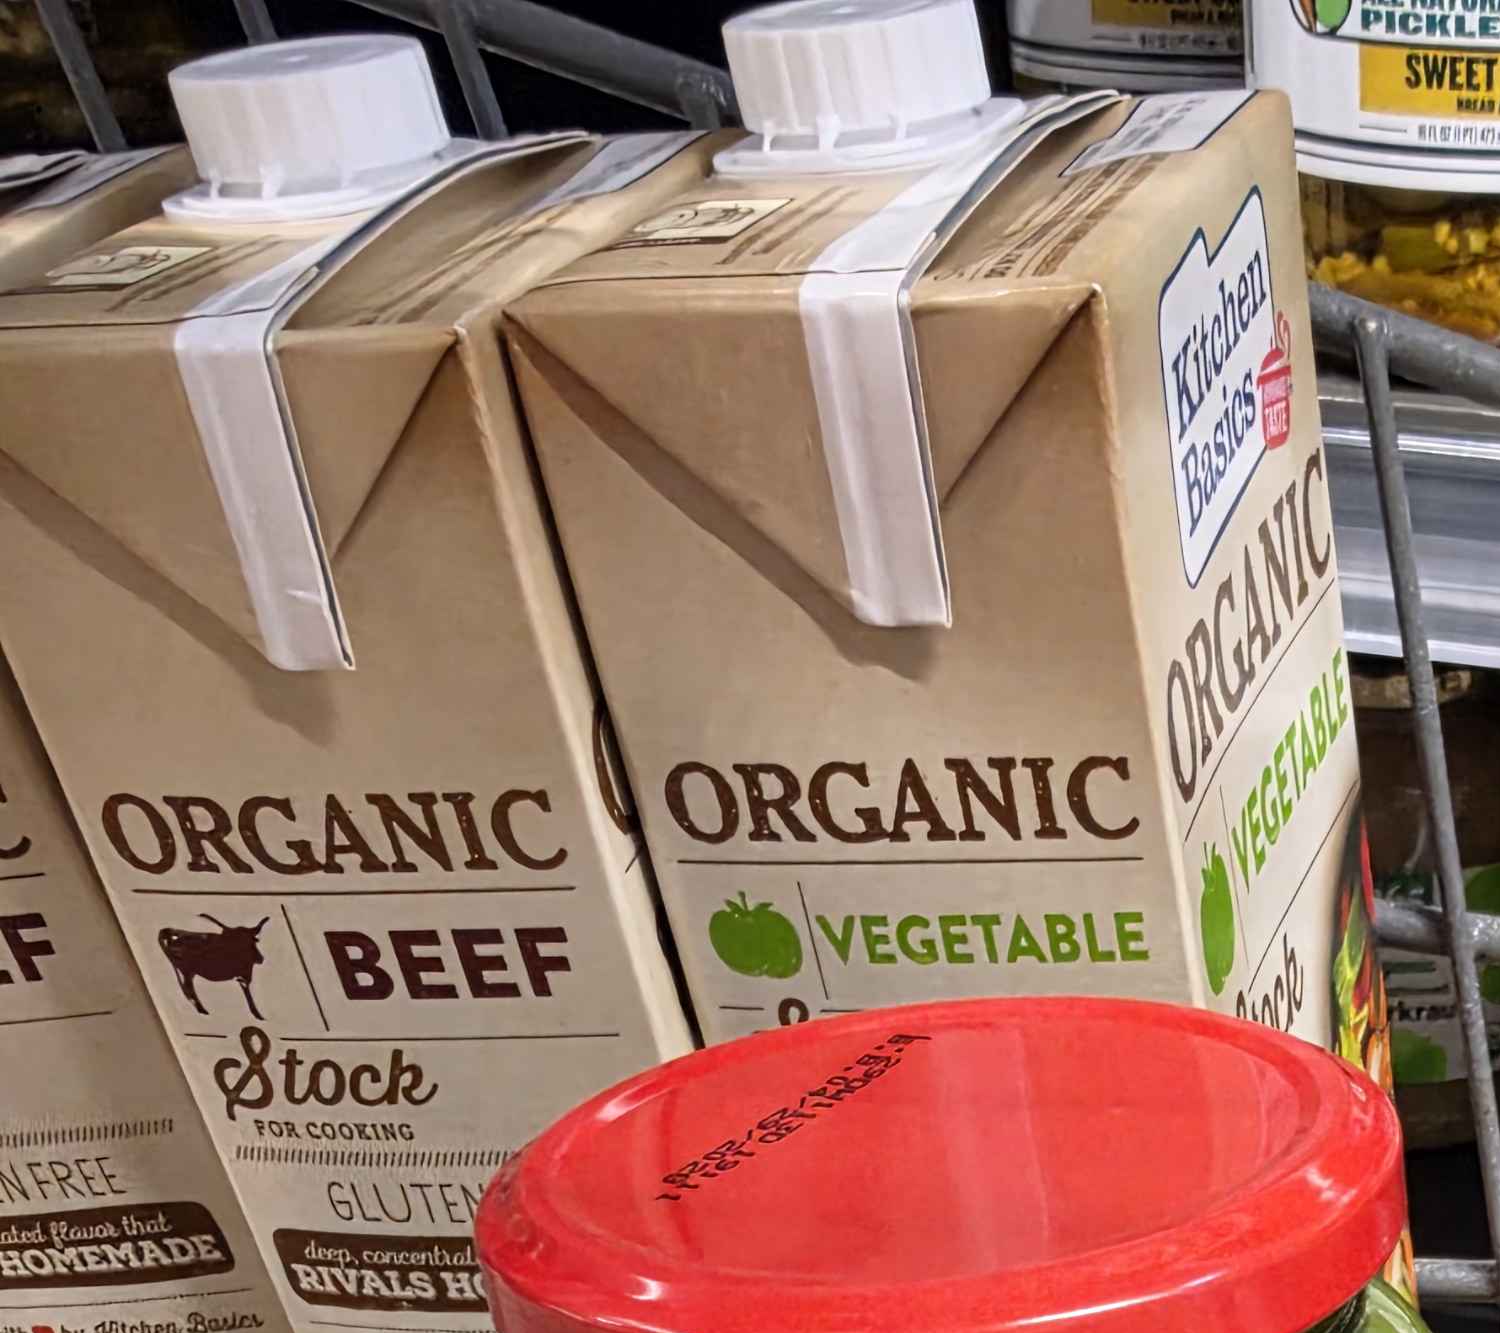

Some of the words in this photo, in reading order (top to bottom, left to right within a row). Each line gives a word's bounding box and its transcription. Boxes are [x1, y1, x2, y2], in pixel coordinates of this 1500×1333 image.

[1405, 52, 1498, 91] SWEET
[1171, 249, 1267, 444] Kitchen
[1181, 367, 1257, 538] Basics
[1166, 447, 1332, 803] ORGANIC
[1230, 646, 1349, 894] VEGETABLE
[665, 755, 1140, 844] ORGANIC
[102, 789, 568, 875] ORGANIC
[323, 926, 572, 1001] BEEF
[815, 911, 1151, 967] VEGETABLE
[213, 1025, 440, 1121] Stock
[253, 1119, 300, 1139] FOR
[305, 1121, 416, 1142] COOKING
[27, 1156, 128, 1199] FREE
[326, 1180, 482, 1224] GLUTEN
[0, 1232, 227, 1278] HOMEMADE
[50, 1218, 119, 1249] flavor
[122, 1210, 174, 1237] that
[362, 1246, 477, 1267] concentrat
[290, 1262, 437, 1299] RIVALS
